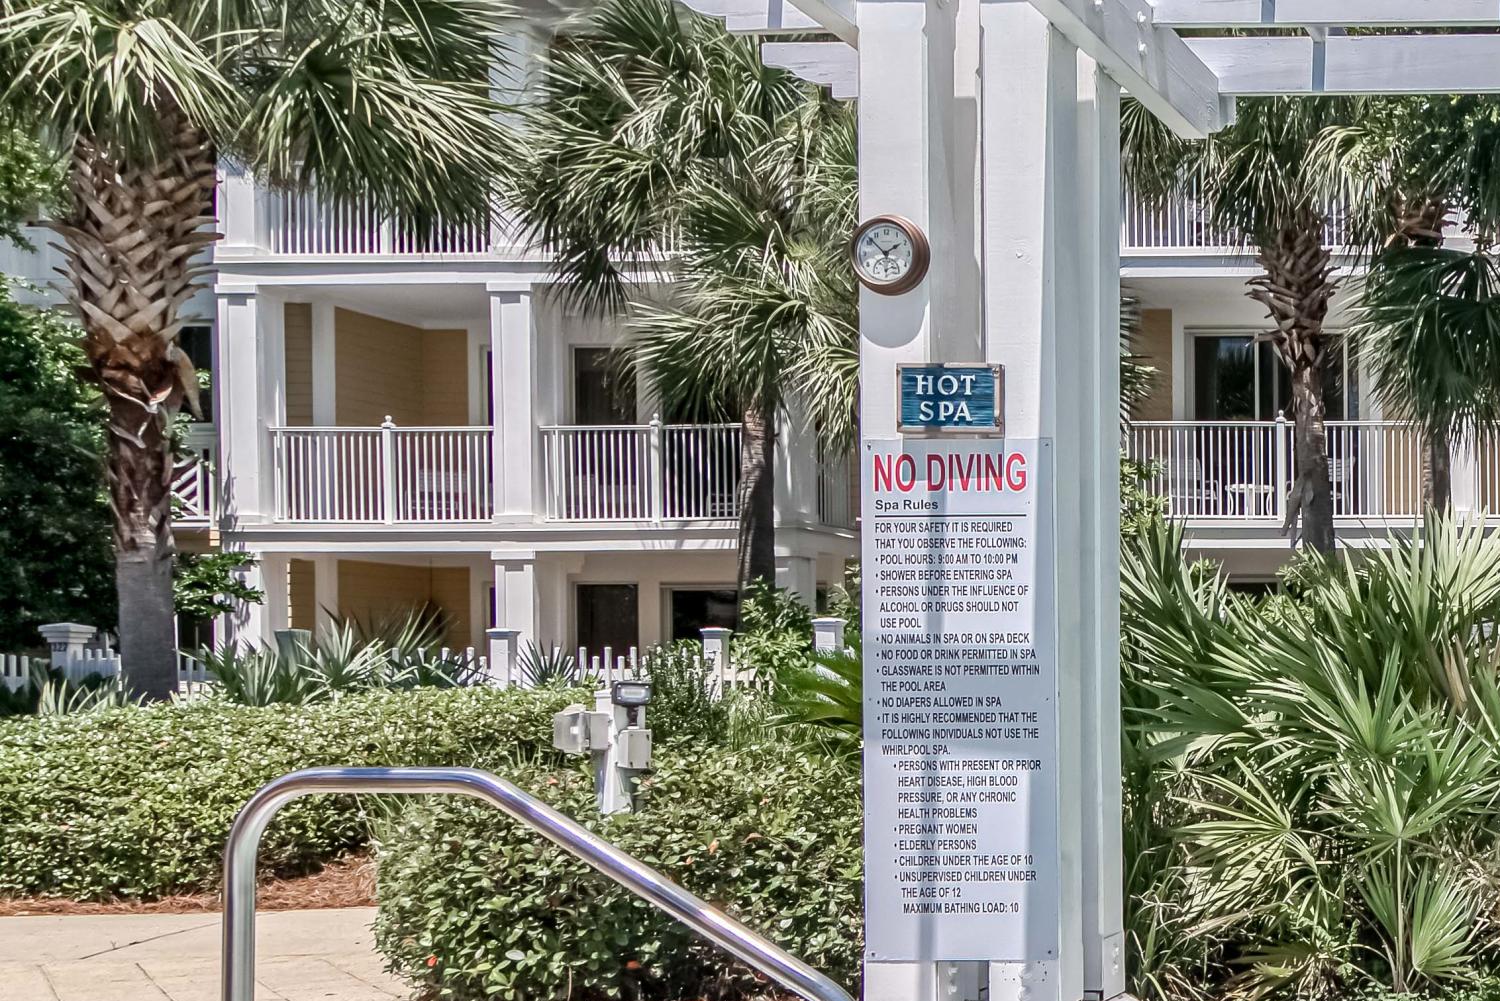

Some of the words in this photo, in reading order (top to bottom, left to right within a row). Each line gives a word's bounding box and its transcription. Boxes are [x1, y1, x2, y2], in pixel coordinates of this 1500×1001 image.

[916, 375, 976, 395] HOT
[919, 401, 973, 422] SPA
[874, 454, 916, 492] NO
[927, 453, 1026, 491] DIVING
[875, 500, 899, 511] Spa
[904, 499, 938, 509] Rules
[875, 523, 891, 532] FOR
[895, 523, 916, 532] YOUR
[919, 523, 950, 532] SAFETY
[952, 523, 958, 532] IT
[962, 522, 968, 532] IS
[971, 522, 1012, 532] REQUIRED
[876, 539, 895, 548] THAT
[898, 539, 914, 548] YOU
[917, 538, 955, 548] OBSERVE
[958, 538, 973, 548] THE
[976, 538, 1026, 548] FOLLOWING:
[880, 555, 902, 564] POOL
[905, 555, 935, 564] HOURS:
[938, 554, 954, 564] 9:00
[956, 554, 968, 564] AM
[971, 554, 981, 563] TO
[984, 554, 1003, 563] 10:00
[1006, 554, 1017, 563] PM
[880, 571, 916, 580] SHOWER
[919, 570, 951, 580] BEFORE
[954, 570, 994, 580] ENTERING
[996, 570, 1012, 579] SPA
[880, 587, 919, 596] PERSONS
[922, 586, 949, 596] UNDER
[952, 586, 967, 596] THE
[970, 586, 1015, 595] INFLUENCE
[1018, 586, 1028, 595] OF
[880, 602, 919, 612] ALCOHOL
[921, 602, 933, 612] OR
[936, 602, 963, 611] DRUGS
[966, 602, 999, 611] SHOULD
[1002, 602, 1018, 611] NOT
[880, 618, 896, 628] USE
[899, 618, 921, 628] POOL
[882, 634, 893, 644] NO
[895, 634, 930, 643] ANIMALS
[934, 634, 940, 643] IN
[943, 634, 959, 643] SPA
[961, 633, 973, 643] OR
[975, 633, 986, 643] ON
[989, 633, 1004, 643] SPA
[1007, 633, 1029, 643] DECK
[882, 650, 893, 660] NO
[896, 650, 918, 659] FOOD
[921, 650, 932, 659] OR
[935, 650, 959, 659] DRINK
[962, 649, 1007, 659] PERMITTED
[1010, 649, 1017, 659] IN
[1020, 649, 1036, 659] SPA
[882, 666, 932, 675] GLASSWARE
[935, 665, 942, 675] IS
[945, 665, 961, 675] NOT
[964, 665, 1009, 675] PERMITTED
[1011, 665, 1039, 674] WITHIN
[882, 682, 897, 691] THE
[899, 682, 921, 691] POOL
[924, 682, 946, 691] AREA
[882, 698, 894, 707] NO
[897, 697, 931, 707] DIAPERS
[933, 697, 973, 707] ALLOWED
[976, 697, 983, 706] IN
[986, 697, 1001, 706] SPA
[882, 713, 889, 723] IT
[892, 713, 899, 723] IS
[902, 713, 930, 723] HIGHLY
[933, 713, 996, 722] RECOMMENDED
[999, 712, 1019, 722] THAT
[1021, 712, 1037, 722] THE
[882, 729, 930, 739] FOLLOWING
[933, 729, 983, 738] INDIVIDUALS
[986, 728, 1002, 738] NOT
[1005, 728, 1020, 738] USE
[1023, 728, 1038, 738] THE
[882, 745, 931, 755] WHIRLPOOL
[933, 745, 950, 755] SPA.
[899, 761, 937, 771] PERSONS
[940, 761, 959, 770] WITH
[962, 760, 999, 770] PRESENT
[1002, 760, 1013, 770] OR
[1016, 760, 1041, 770] PRIOR
[899, 777, 925, 786] HEART
[928, 777, 964, 788] DISEASE,
[967, 776, 986, 786] HIGH
[990, 776, 1017, 786] BLOOD
[899, 793, 944, 804] PRESSURE,
[947, 792, 958, 802] OR
[960, 792, 978, 802] ANY
[979, 792, 1016, 801] CHRONIC
[899, 809, 929, 818] HEALTH
[932, 808, 977, 818] PROBLEMS
[899, 824, 943, 834] PREGNANT
[946, 824, 977, 833] WOMEN
[900, 840, 935, 850] ELDERLY
[938, 840, 976, 849] PERSONS
[900, 856, 940, 866] CHILDREN
[943, 856, 970, 865] UNDER
[973, 855, 989, 865] THE
[991, 855, 1008, 865] AGE
[1011, 855, 1022, 865] OF
[1025, 855, 1033, 865] 10
[900, 872, 962, 882] UNSUPERVISED
[965, 871, 1005, 881] CHILDREN
[1008, 871, 1036, 881] UNDER
[902, 888, 917, 898] THE
[920, 888, 936, 897] AGE
[939, 887, 950, 897] OF
[952, 887, 961, 897] 12
[904, 903, 942, 913] MAXIMUM
[945, 903, 979, 913] BATHING
[982, 903, 1007, 912] LOAD:
[1010, 902, 1018, 912] 10
